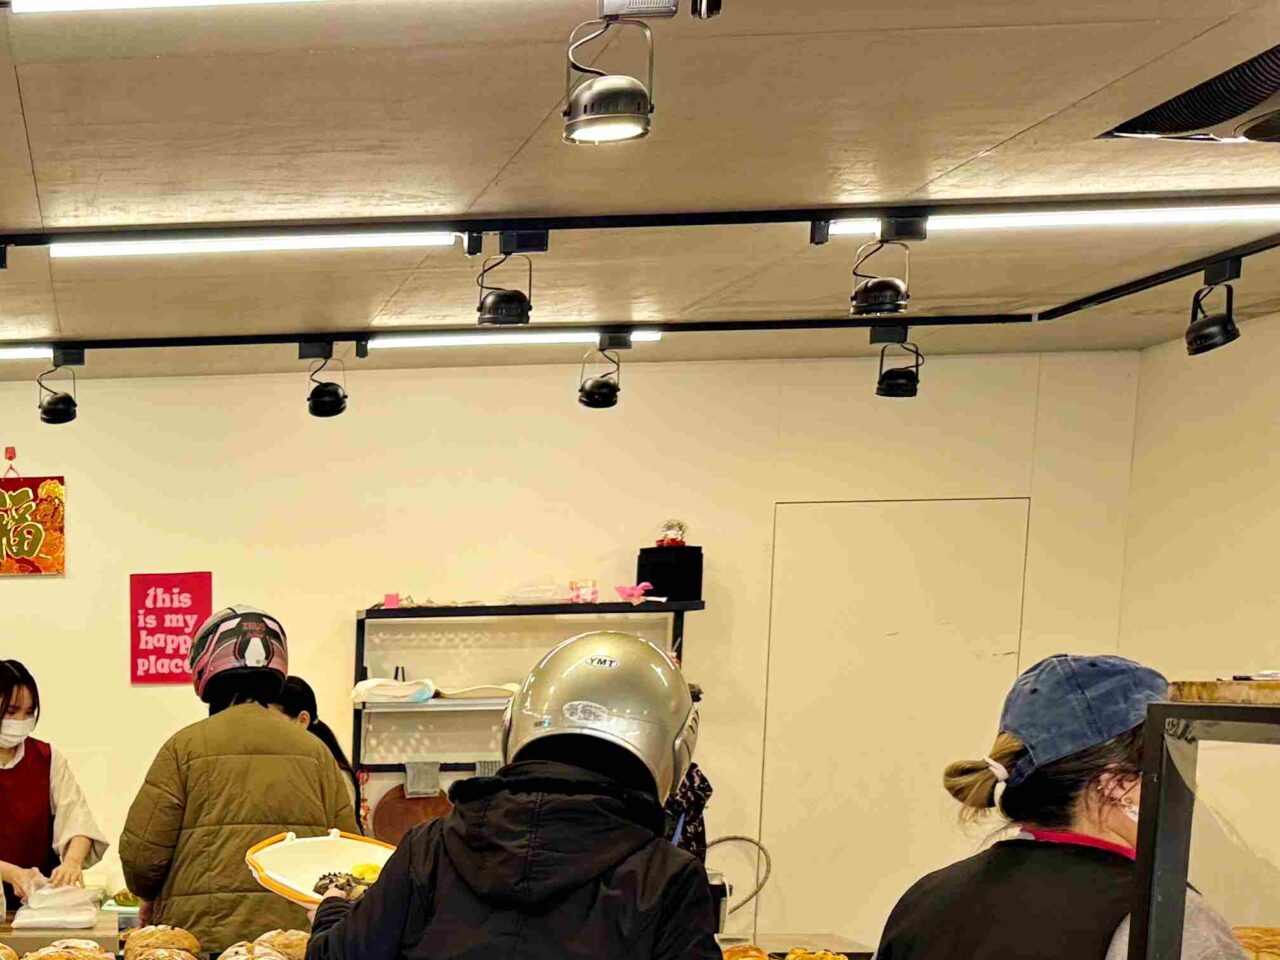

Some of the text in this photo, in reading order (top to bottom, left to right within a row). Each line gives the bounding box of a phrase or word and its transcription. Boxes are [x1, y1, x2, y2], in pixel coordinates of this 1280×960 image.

[145, 586, 192, 608] this
[137, 609, 199, 633] is my
[139, 630, 192, 655] happ
[589, 657, 616, 668] YMT
